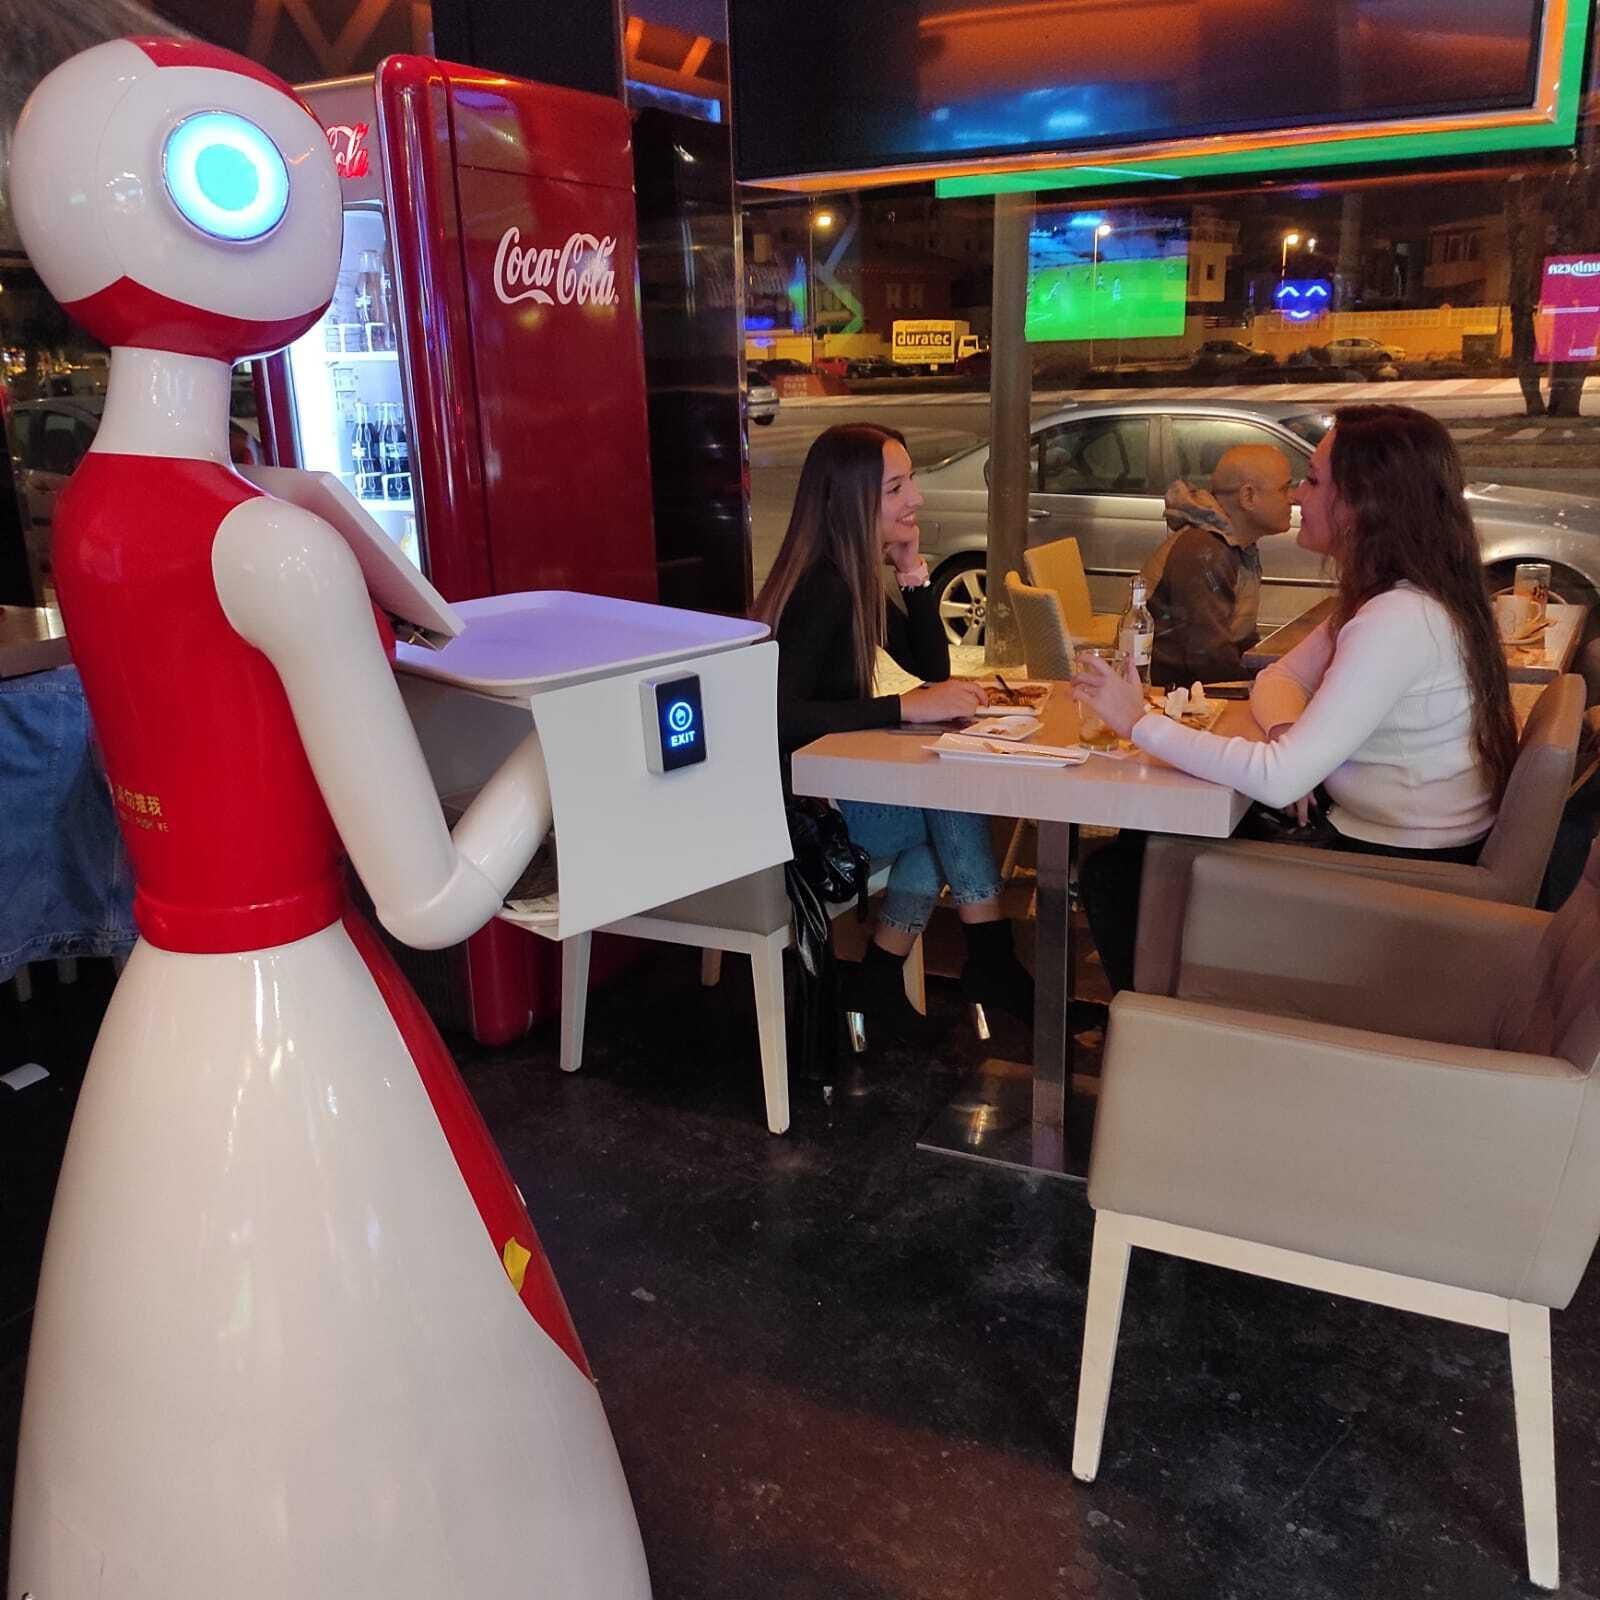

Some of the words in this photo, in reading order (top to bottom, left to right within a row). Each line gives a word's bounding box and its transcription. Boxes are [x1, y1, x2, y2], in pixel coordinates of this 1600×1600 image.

[493, 226, 617, 305] Coca-Cola
[896, 330, 950, 345] duratec
[671, 730, 695, 747] EXIT
